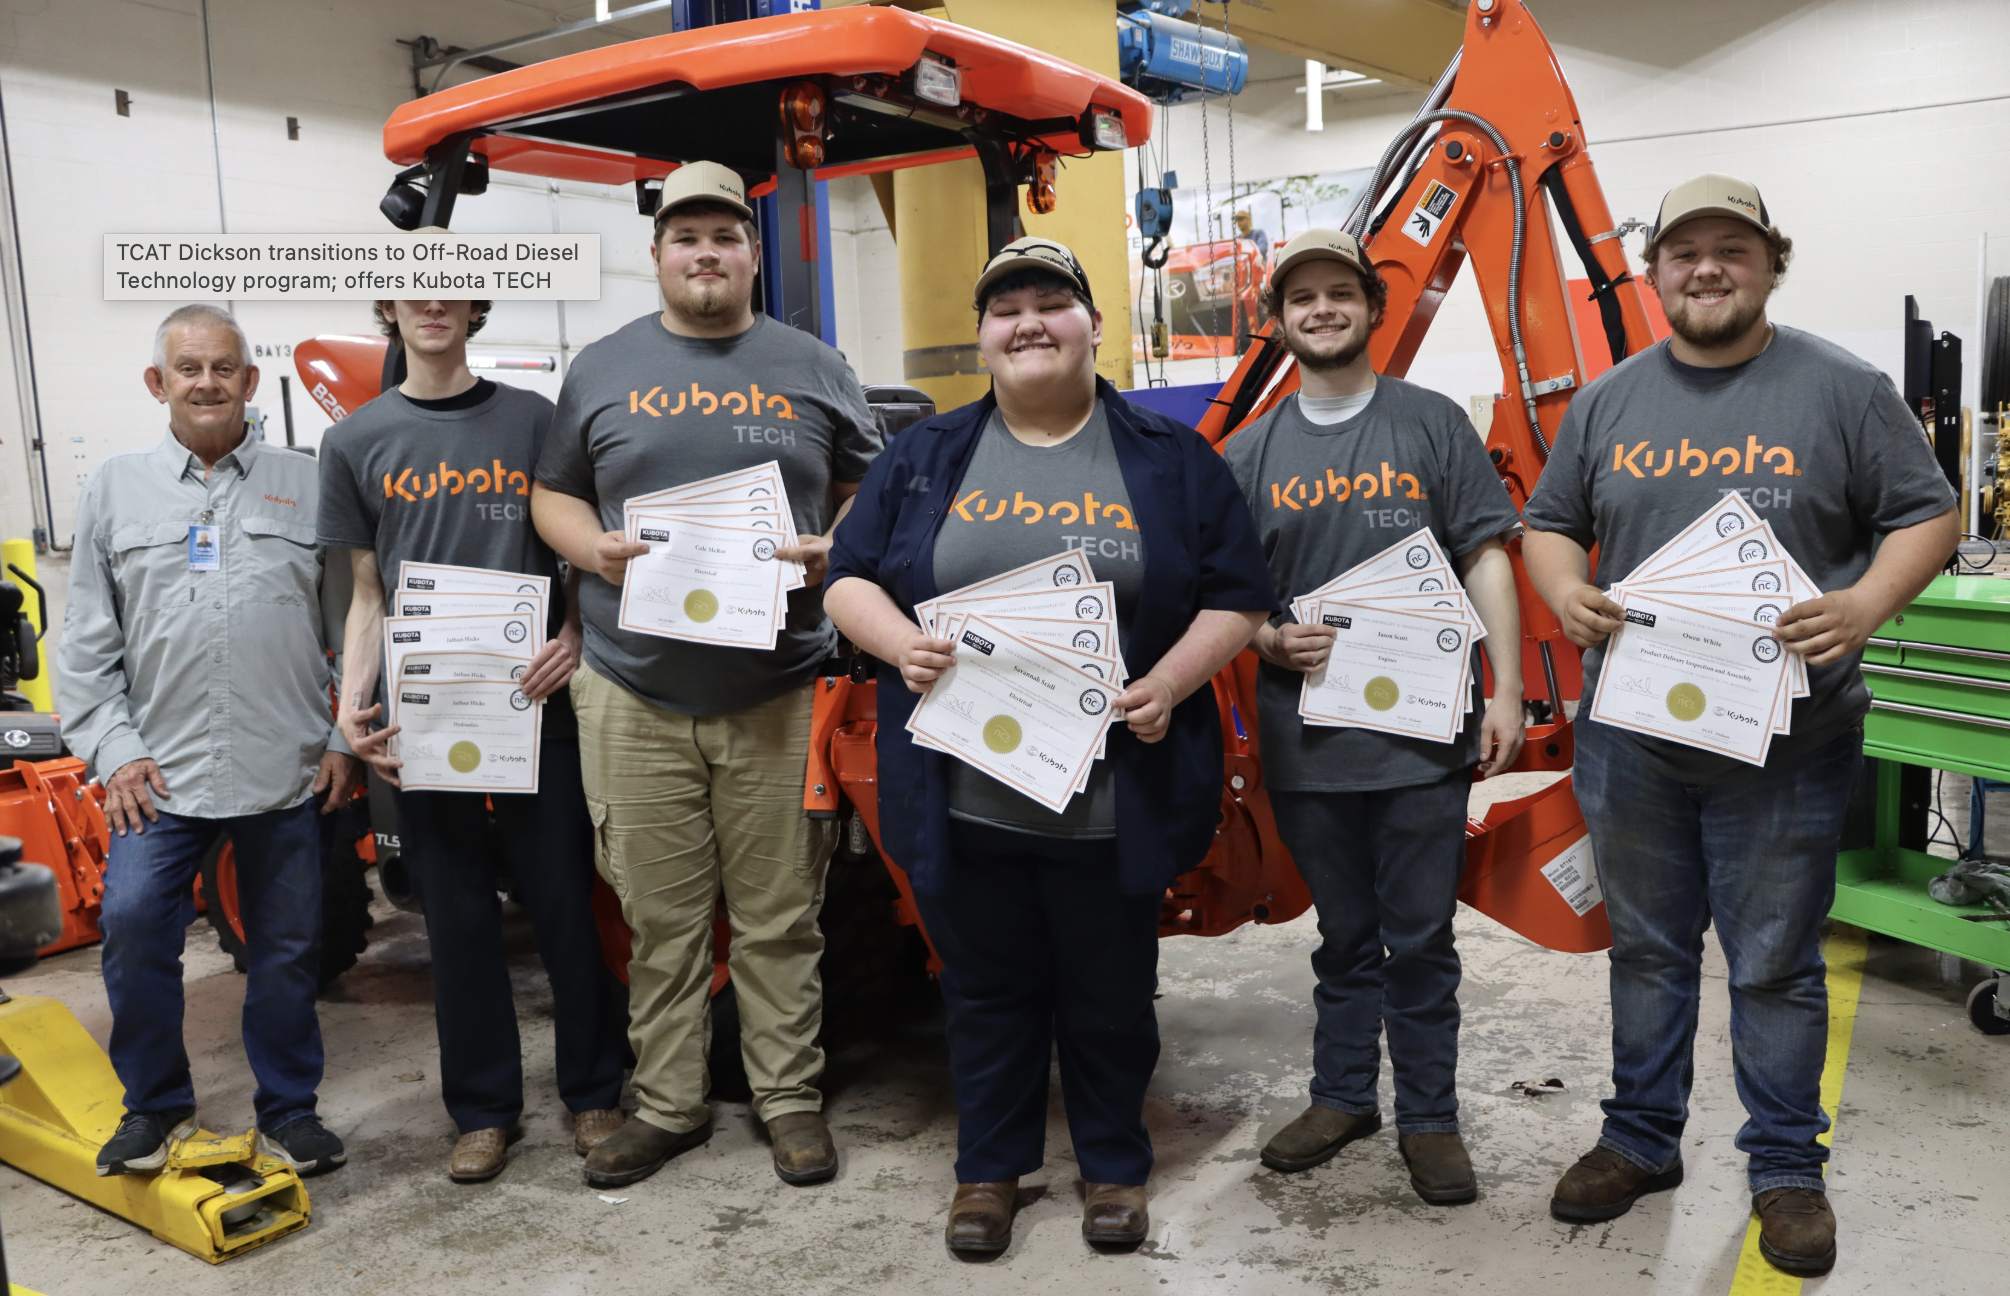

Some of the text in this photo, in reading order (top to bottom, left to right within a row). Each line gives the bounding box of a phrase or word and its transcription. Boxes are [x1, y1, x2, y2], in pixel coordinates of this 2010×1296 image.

[1172, 39, 1221, 67] SHAW BOX
[719, 183, 742, 198] Kubota
[1728, 196, 1756, 210] Kubota
[1328, 243, 1355, 256] Kubota
[630, 382, 793, 420] Kubota
[1478, 402, 1483, 412] 5
[732, 425, 796, 446] TECH
[1612, 435, 1794, 478] Kubota
[384, 459, 530, 502] Kubota
[1271, 462, 1420, 511] Kubota
[264, 494, 297, 507] Kubota
[476, 504, 527, 521] TECH
[948, 490, 1134, 530] Kubota
[1363, 508, 1421, 528] TECH
[1723, 518, 1740, 534] nc3
[695, 544, 707, 552] Cole
[1061, 536, 1140, 562] TECH
[1744, 548, 1762, 560] nc3
[408, 578, 434, 586] KUBOTA
[1059, 574, 1076, 584] nc3
[1758, 582, 1776, 590] nc3
[694, 602, 709, 612] nc3
[738, 607, 766, 616] Kubota
[1082, 606, 1098, 614] nc3
[1324, 616, 1350, 624] KUBOTA
[1626, 610, 1654, 622] KUBOTA
[966, 632, 992, 650] KUBOTA
[1078, 640, 1096, 650] nc3
[1394, 634, 1408, 642] Scott
[1441, 636, 1457, 646] nc3
[1682, 632, 1722, 648] Owen White
[1758, 644, 1775, 657] nc3
[1640, 648, 1662, 658] Product
[1662, 654, 1685, 666] Delivery
[1685, 659, 1714, 673] Inspection
[1726, 671, 1752, 683] Assembly
[1013, 665, 1056, 691] Savannah Seidl
[1008, 692, 1033, 708] Electrical
[1084, 694, 1102, 710] nc3
[1374, 690, 1390, 700] nc3
[1418, 697, 1446, 708] Kubota
[1678, 697, 1694, 709] nc3
[1728, 710, 1759, 726] Kubota
[994, 729, 1010, 743] nc3
[1039, 752, 1068, 774] Kubota
